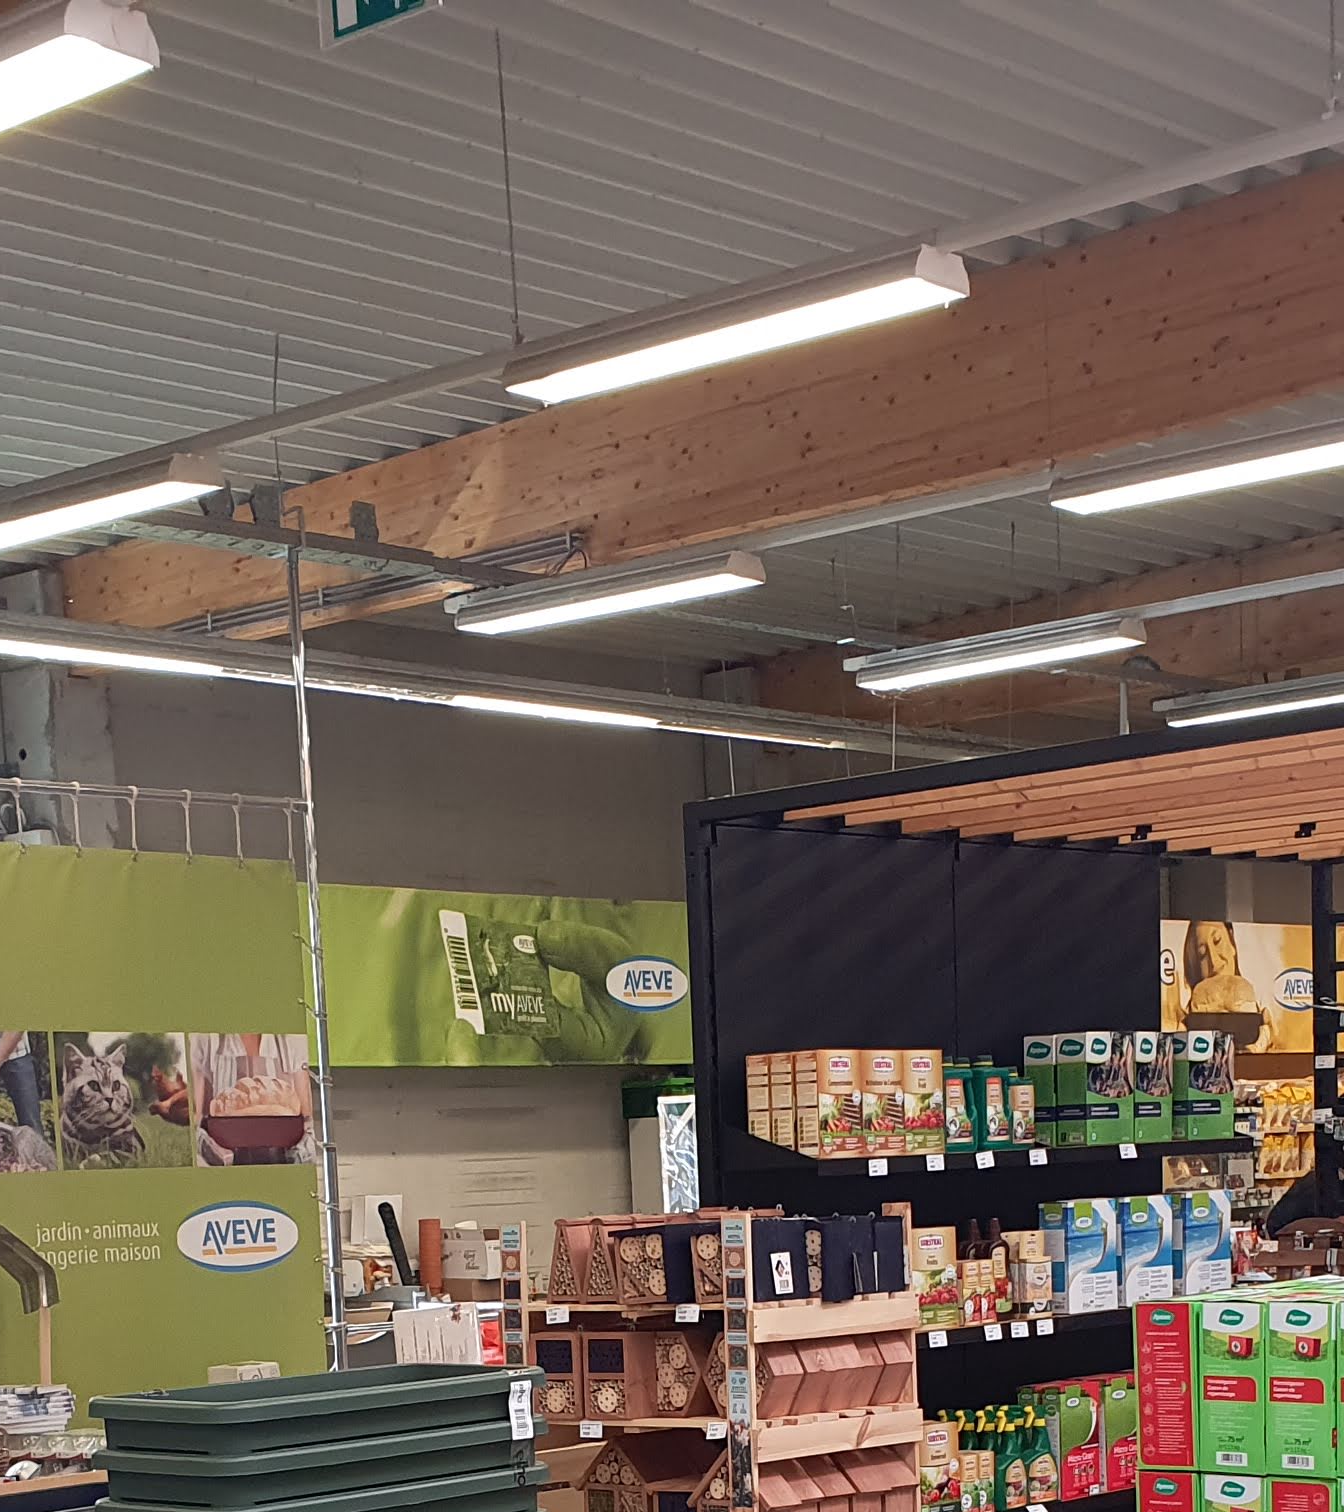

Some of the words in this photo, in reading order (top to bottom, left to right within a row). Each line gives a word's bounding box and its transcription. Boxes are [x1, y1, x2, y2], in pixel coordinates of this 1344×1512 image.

[624, 969, 673, 997] AVEVE
[490, 992, 515, 1020] my
[516, 995, 546, 1015] AVEVE
[35, 1221, 82, 1248] jardin
[93, 1219, 160, 1241] animaux
[203, 1218, 276, 1254] AVEVE
[104, 1243, 161, 1263] maison
